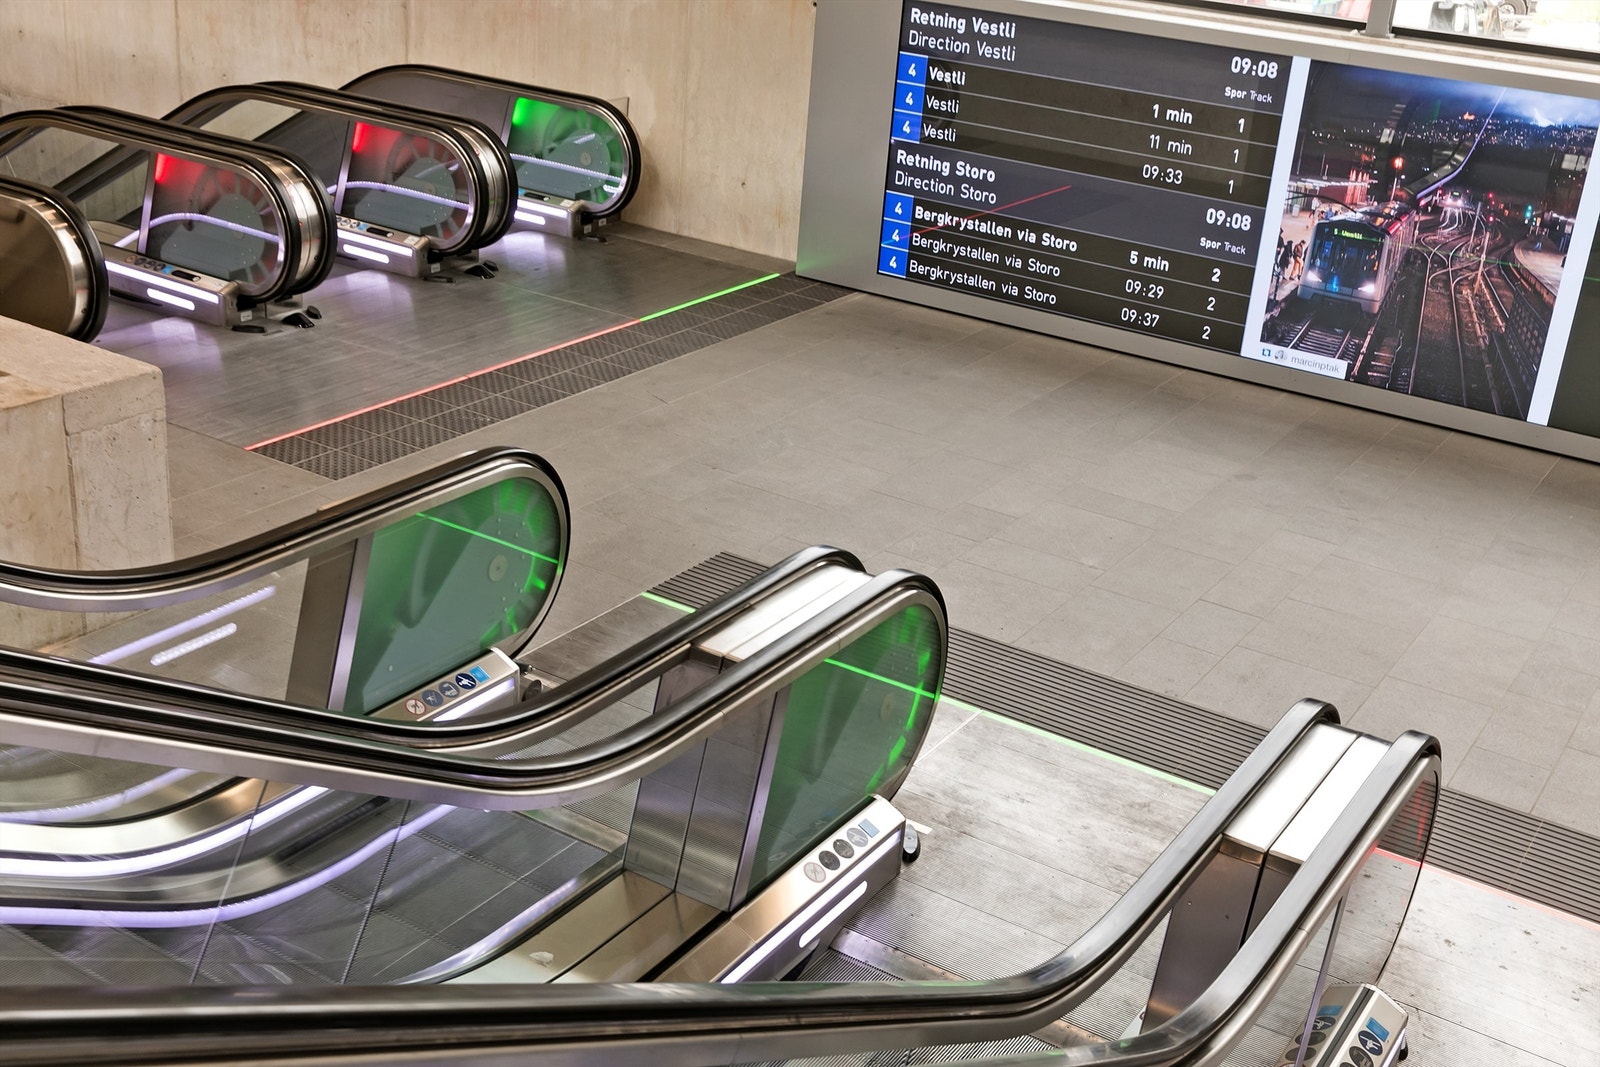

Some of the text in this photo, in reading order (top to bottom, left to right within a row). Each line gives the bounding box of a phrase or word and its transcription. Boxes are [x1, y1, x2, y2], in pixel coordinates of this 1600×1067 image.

[910, 8, 1016, 39] Retning Vestli
[908, 30, 1016, 62] Direction Vestli
[1231, 57, 1278, 79] 09:08
[907, 63, 1245, 133] 4 Vestli 1 min 1
[1225, 87, 1273, 103] Spor Track
[905, 92, 1240, 163] 4 Vestli 11 min 1
[897, 149, 995, 182] Retning Storo
[902, 121, 1234, 194] 4 Vestli 09:33 1
[895, 170, 997, 204] Direction Storo
[1206, 208, 1251, 231] 09:08
[894, 202, 1220, 282] 4 Bergkrystallen via Storo 5 min 2
[1200, 237, 1246, 255] Spor Track
[891, 228, 1216, 311] 4 Bergkrystallen via Storo 09:29 2
[889, 256, 1211, 340] 4 Bergkrystallen via Storo 09:37 2
[1291, 356, 1339, 373] marcinptak
